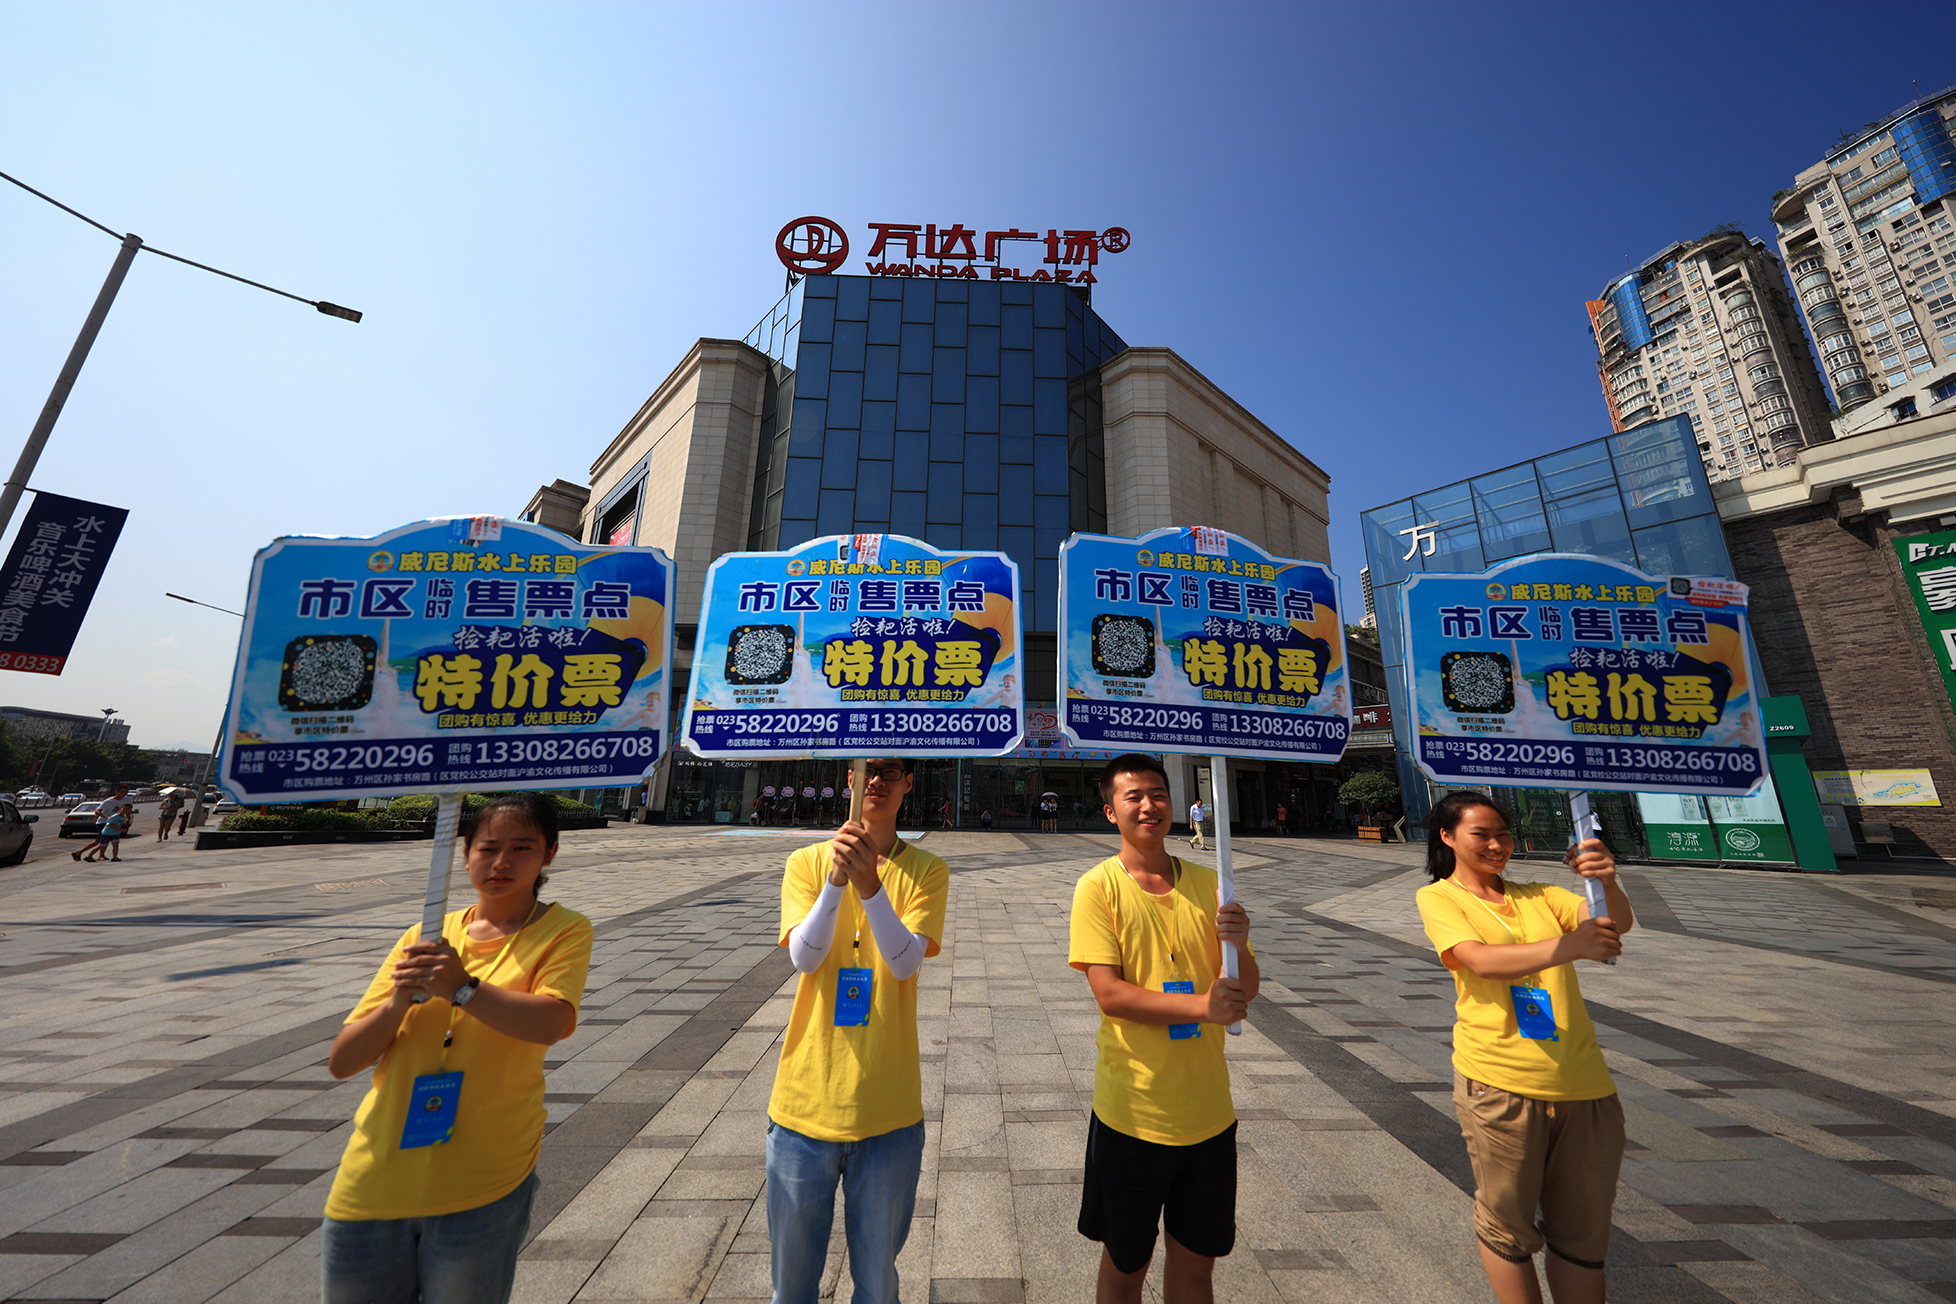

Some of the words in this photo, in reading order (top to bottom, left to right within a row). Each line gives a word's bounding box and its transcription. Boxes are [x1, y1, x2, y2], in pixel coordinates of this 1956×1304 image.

[868, 222, 1098, 265] 万达广场
[865, 262, 979, 279] WANDA
[990, 267, 1098, 283] PLAZA
[1400, 520, 1440, 561] 万
[40, 516, 105, 608] 水上大冲关
[398, 551, 578, 575] 威尼斯水上乐园
[1158, 552, 1276, 581] 威尼斯水上乐园
[300, 578, 416, 620] 市区
[425, 578, 456, 619] 临时
[465, 578, 631, 620] 售票点
[738, 580, 822, 613] 市区
[829, 579, 851, 612] 临时
[858, 579, 986, 613] 售票点
[1094, 568, 1174, 606] 市区
[1180, 575, 1200, 610] 临时
[1206, 577, 1316, 622] 售票点
[1510, 584, 1656, 603] 威尼斯水上乐园
[1439, 606, 1532, 640] 市区
[1539, 606, 1562, 641] 临时
[1569, 607, 1710, 645] 售票点
[13, 654, 60, 672] 0333
[824, 640, 983, 687] 特价票
[1183, 639, 1320, 694] 特价票
[415, 653, 624, 711] 特价票
[842, 689, 900, 701] 团购有惊喜
[906, 689, 964, 701] 优惠更给力
[1203, 688, 1253, 703] 团购有惊喜
[1257, 693, 1306, 707] 优惠更给力
[1546, 671, 1718, 724] 特价票
[849, 713, 868, 723] 团购
[1072, 704, 1089, 714] 抢票
[1091, 705, 1109, 716] 023
[1109, 706, 1203, 730] 58220296
[1212, 712, 1228, 722] 团购
[437, 713, 515, 729] 团购有惊喜
[522, 711, 597, 727] 优惠更给力
[696, 715, 715, 725] 抢票
[716, 714, 735, 725] 023
[734, 713, 839, 733] 58220296
[849, 723, 867, 733] 热线
[870, 713, 1012, 733] 13308266708
[1072, 714, 1089, 724] 热线
[1212, 722, 1228, 732] 热线
[1230, 715, 1346, 740] 13308266708
[695, 725, 714, 734] 热线
[1572, 722, 1634, 736] 团购有惊喜
[1639, 726, 1700, 738] 优惠更给力
[448, 743, 472, 754] 团购
[476, 736, 653, 764] 13308266708
[1426, 740, 1444, 750] 抢票
[1426, 750, 1445, 759] 热线
[1446, 741, 1466, 752] 023
[1466, 742, 1575, 765] 58220296
[1585, 747, 1603, 756] 团购
[240, 751, 266, 762] 抢票
[268, 750, 294, 762] 023
[294, 744, 434, 772] 58220296
[447, 754, 472, 765] 热线
[1586, 756, 1605, 766] 热线
[1607, 748, 1757, 773] 13308266708
[238, 762, 264, 774] 热线
